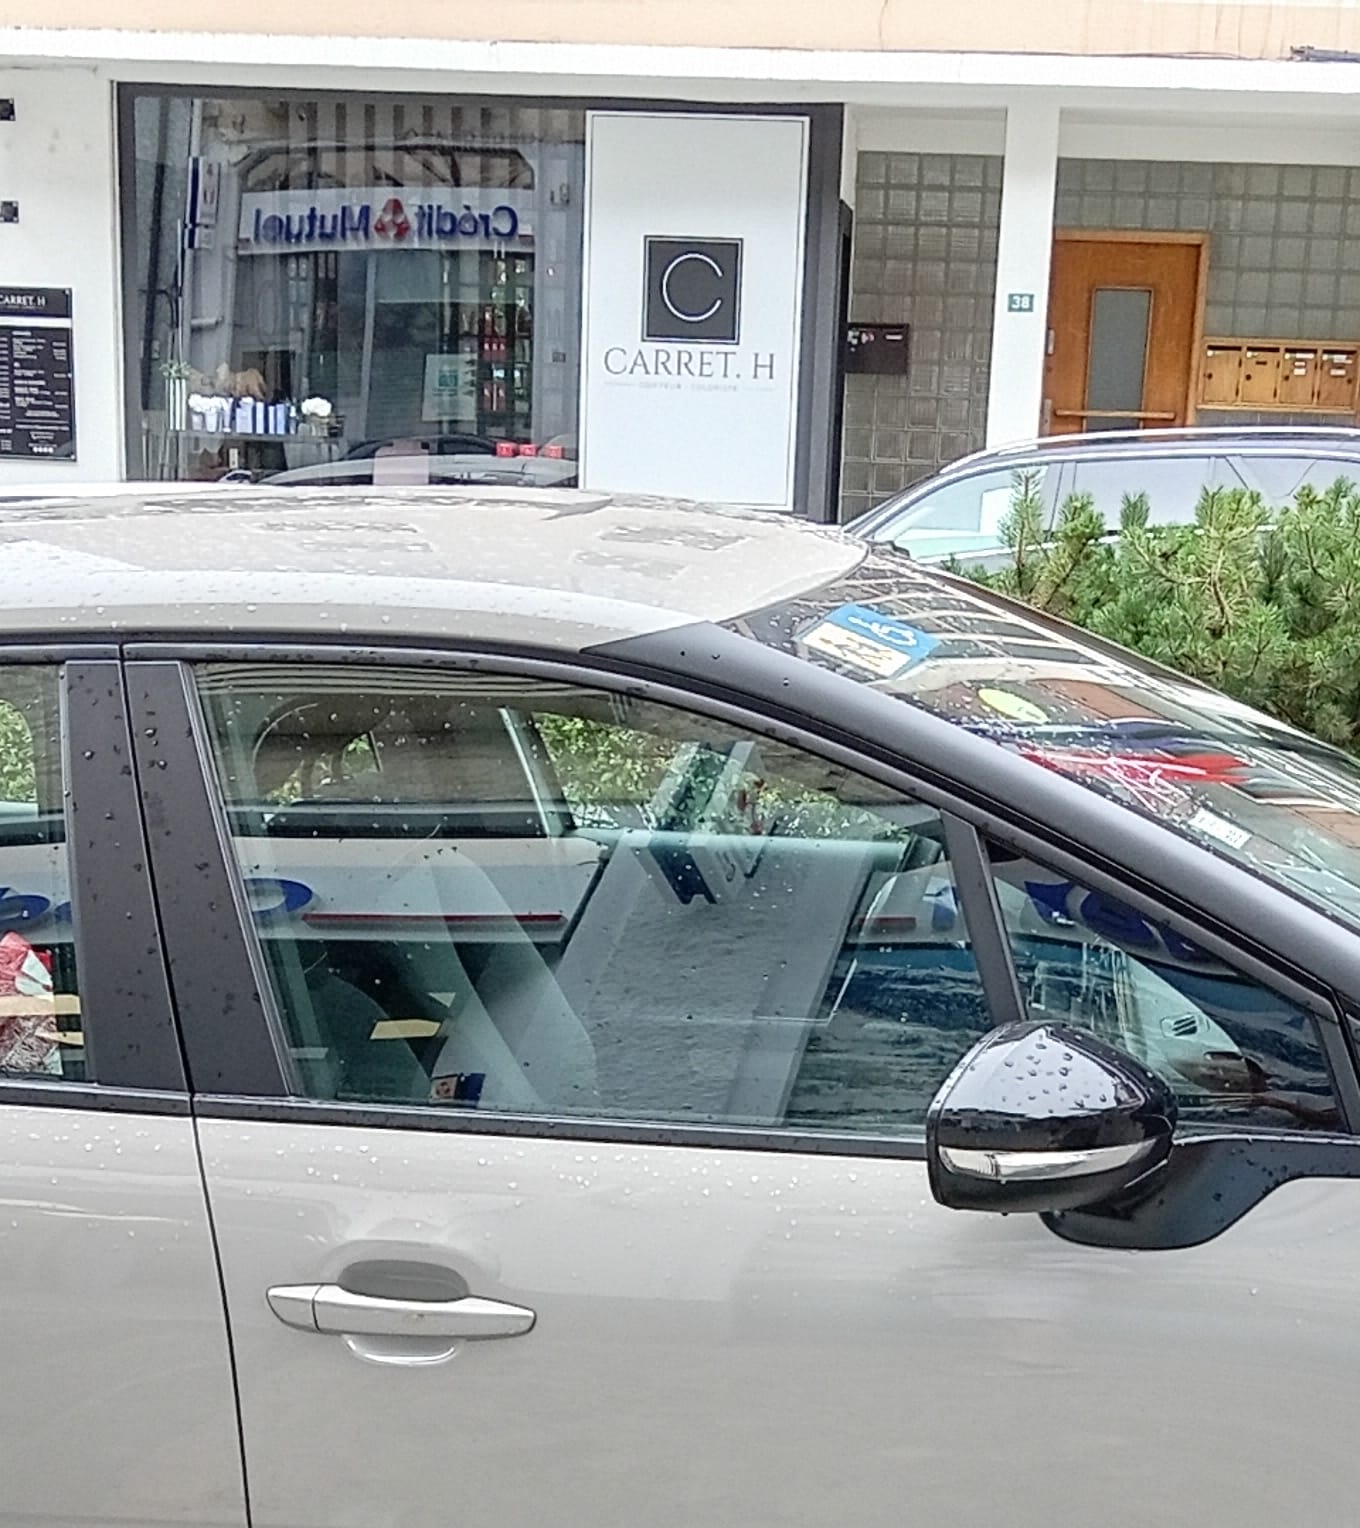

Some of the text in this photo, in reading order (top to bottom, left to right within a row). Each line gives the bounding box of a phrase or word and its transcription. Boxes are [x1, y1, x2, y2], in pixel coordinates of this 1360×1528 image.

[662, 252, 724, 322] C
[1011, 295, 1030, 309] 38
[603, 346, 775, 380] CARRET. H
